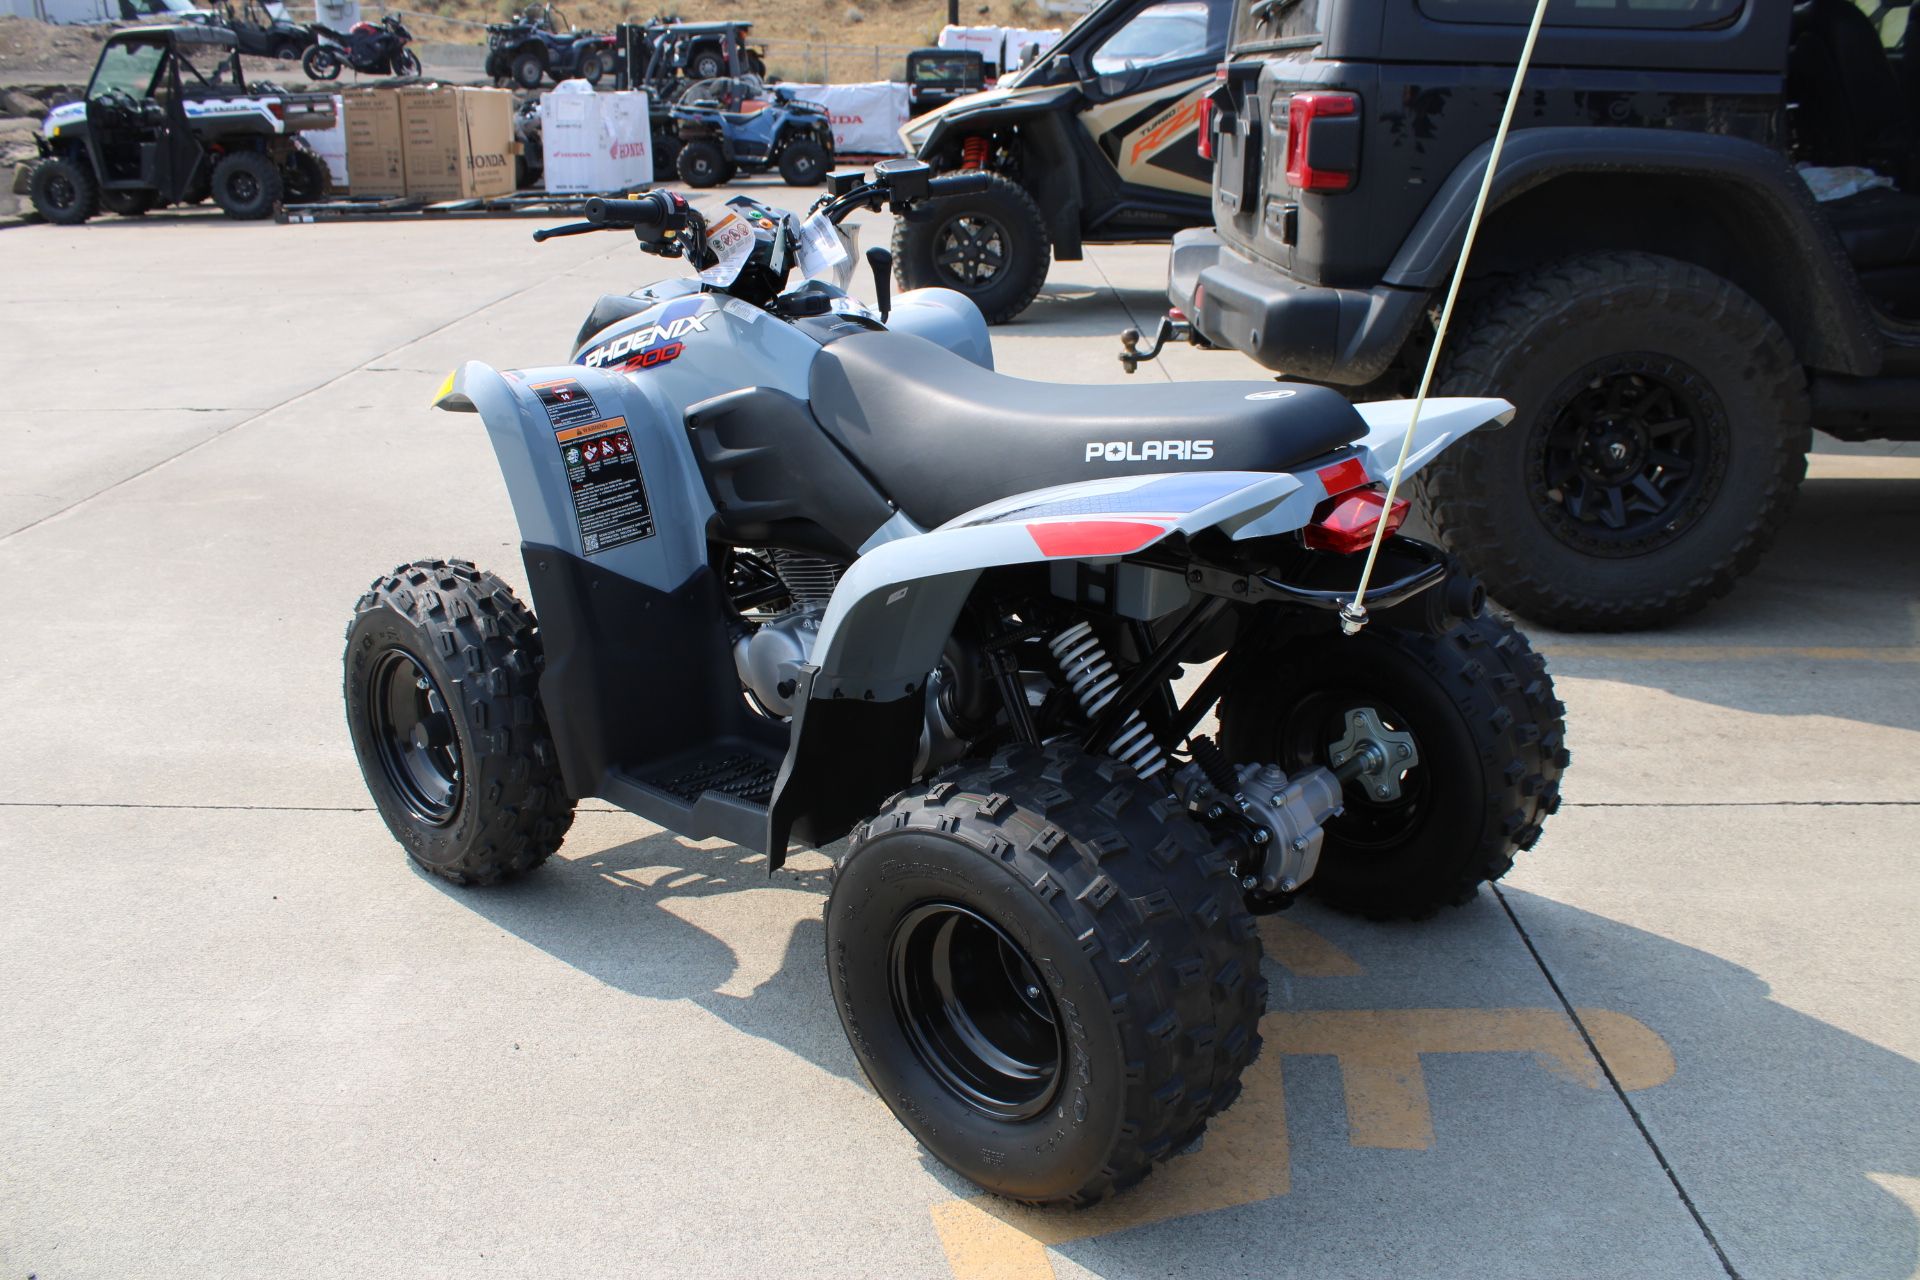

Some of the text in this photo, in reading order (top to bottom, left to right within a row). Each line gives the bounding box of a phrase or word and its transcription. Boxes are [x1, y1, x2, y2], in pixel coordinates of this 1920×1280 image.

[1140, 109, 1177, 137] TURBO
[619, 142, 646, 159] HONDA
[467, 153, 507, 169] HONDA
[584, 312, 715, 368] PHOENIX
[624, 342, 684, 372] 200
[560, 393, 570, 401] 14
[582, 422, 608, 434] WARNING
[1085, 439, 1214, 463] POLARIS
